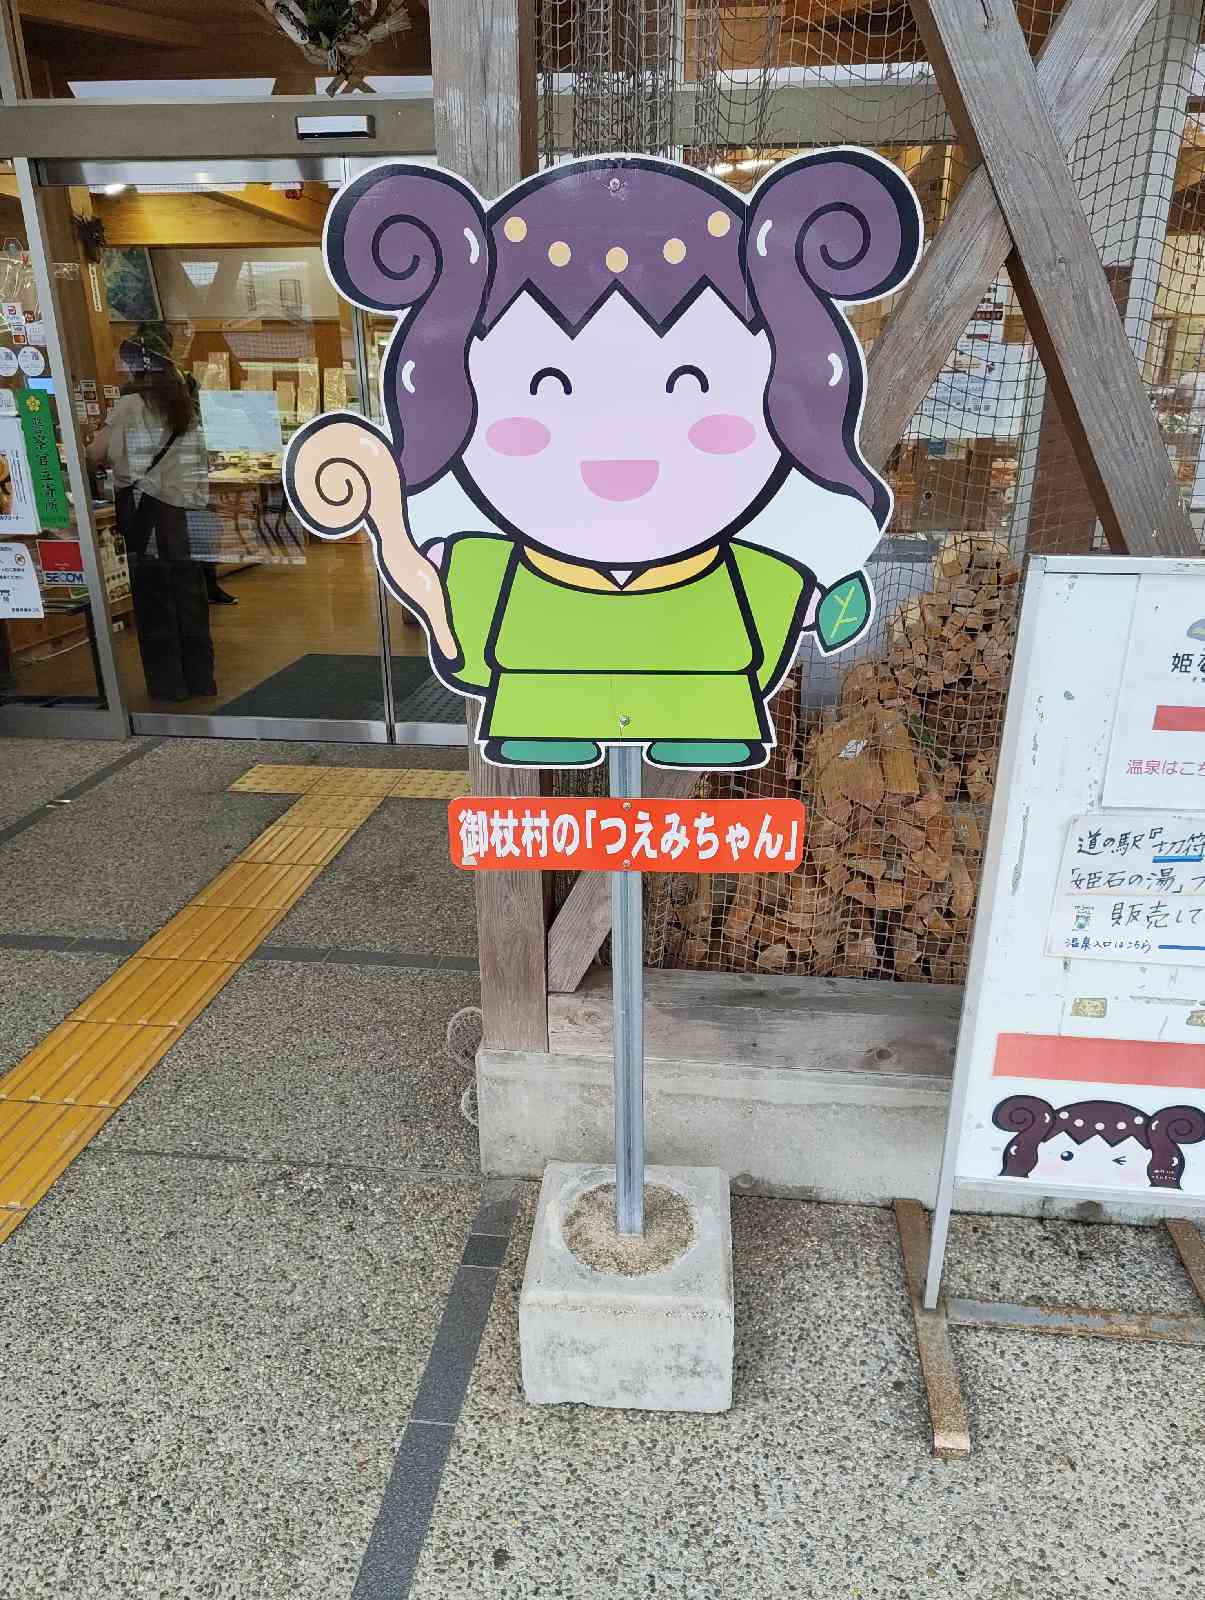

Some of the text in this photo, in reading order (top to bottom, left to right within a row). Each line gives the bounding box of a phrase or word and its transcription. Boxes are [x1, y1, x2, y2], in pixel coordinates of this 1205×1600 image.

[45, 572, 84, 583] SECOM
[457, 808, 798, 864] 御杖村の「つえみちゃん」
